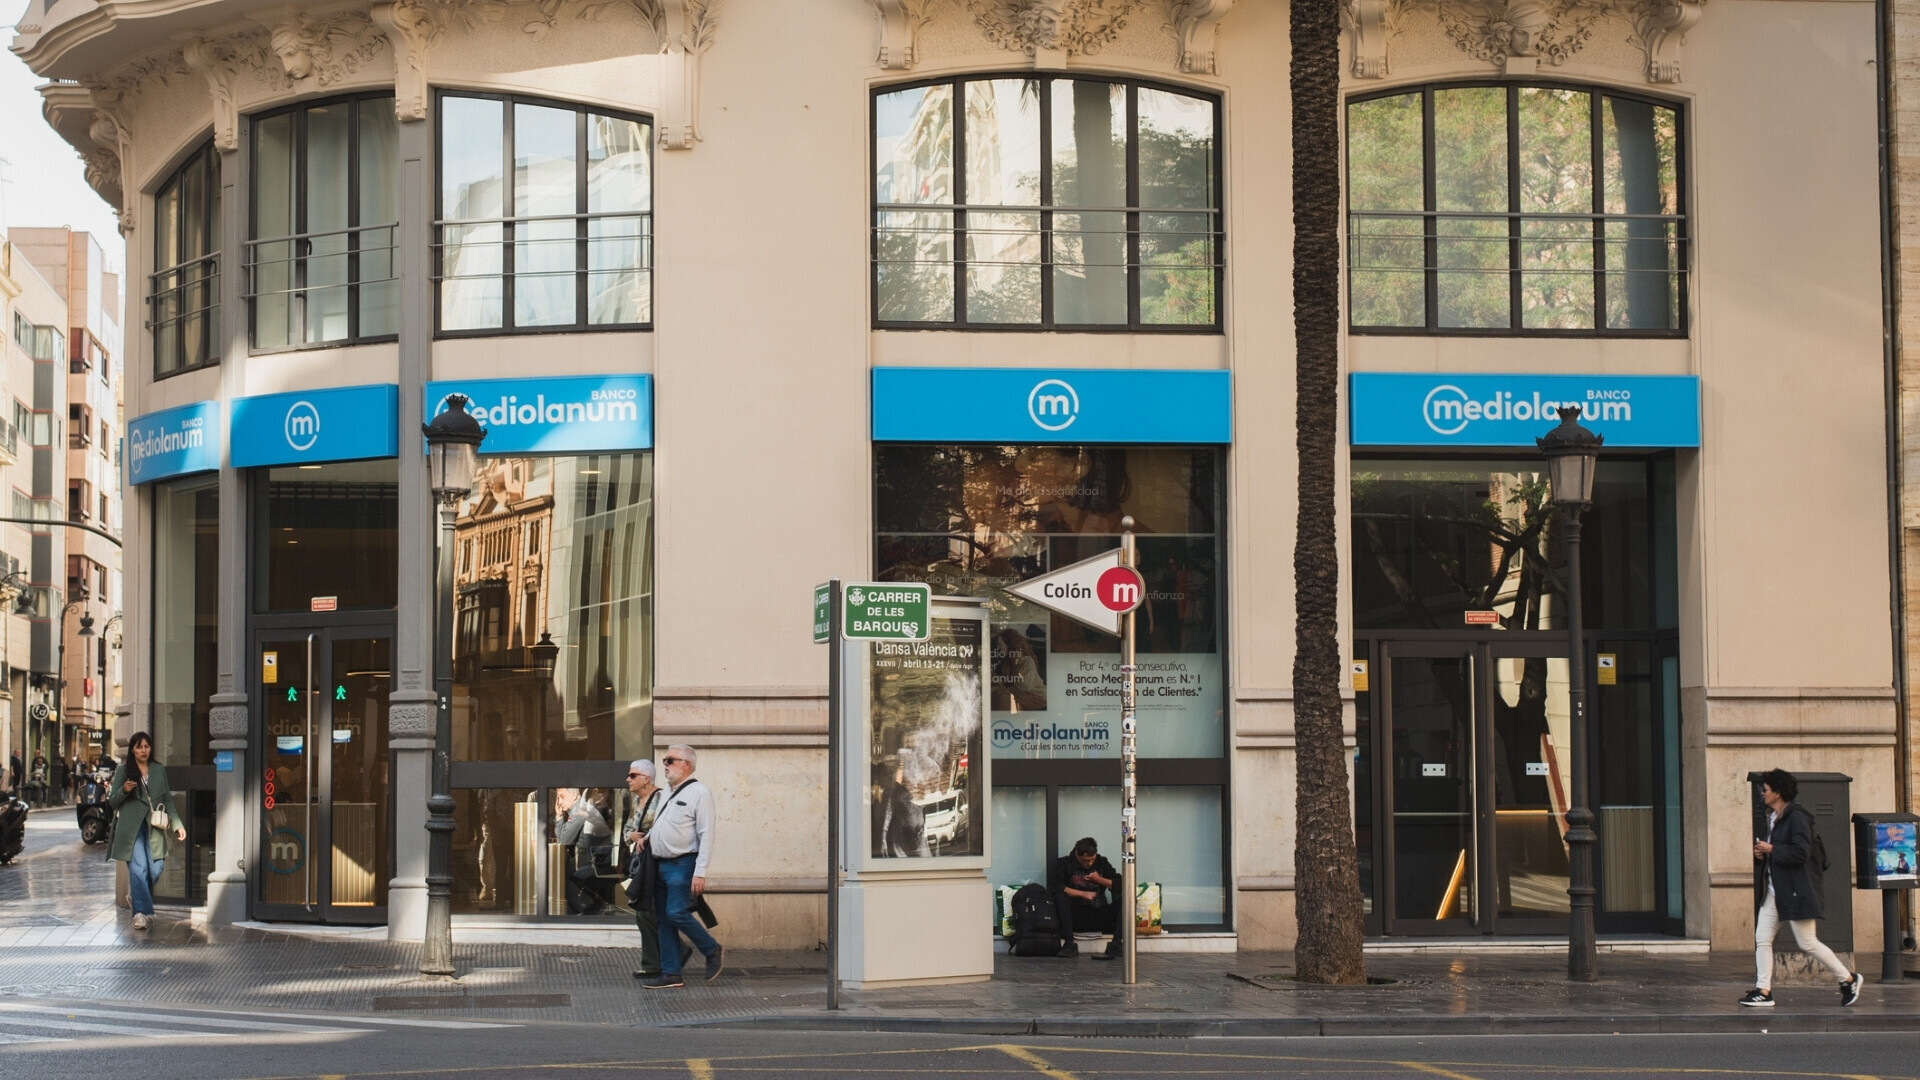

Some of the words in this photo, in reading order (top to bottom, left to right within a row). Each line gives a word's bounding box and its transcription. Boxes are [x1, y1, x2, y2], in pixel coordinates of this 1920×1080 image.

[591, 389, 637, 400] BANCO
[1586, 390, 1631, 400] BANCO
[444, 395, 637, 425] ediolanum
[182, 417, 203, 429] BANCO
[132, 427, 203, 462] mediolanum
[1044, 582, 1091, 600] Colón
[868, 592, 921, 603] CARRER
[867, 607, 881, 616] DE
[885, 608, 904, 616] LES
[875, 641, 910, 655] Dansa
[912, 641, 957, 657] València
[904, 659, 921, 668] abril
[923, 660, 944, 669] 13-21
[1080, 661, 1095, 671] Por
[1068, 673, 1098, 683] Banco
[1065, 688, 1077, 696] en
[1142, 686, 1155, 696] de
[994, 722, 1109, 741] mediolanum
[1068, 743, 1080, 751] tus
